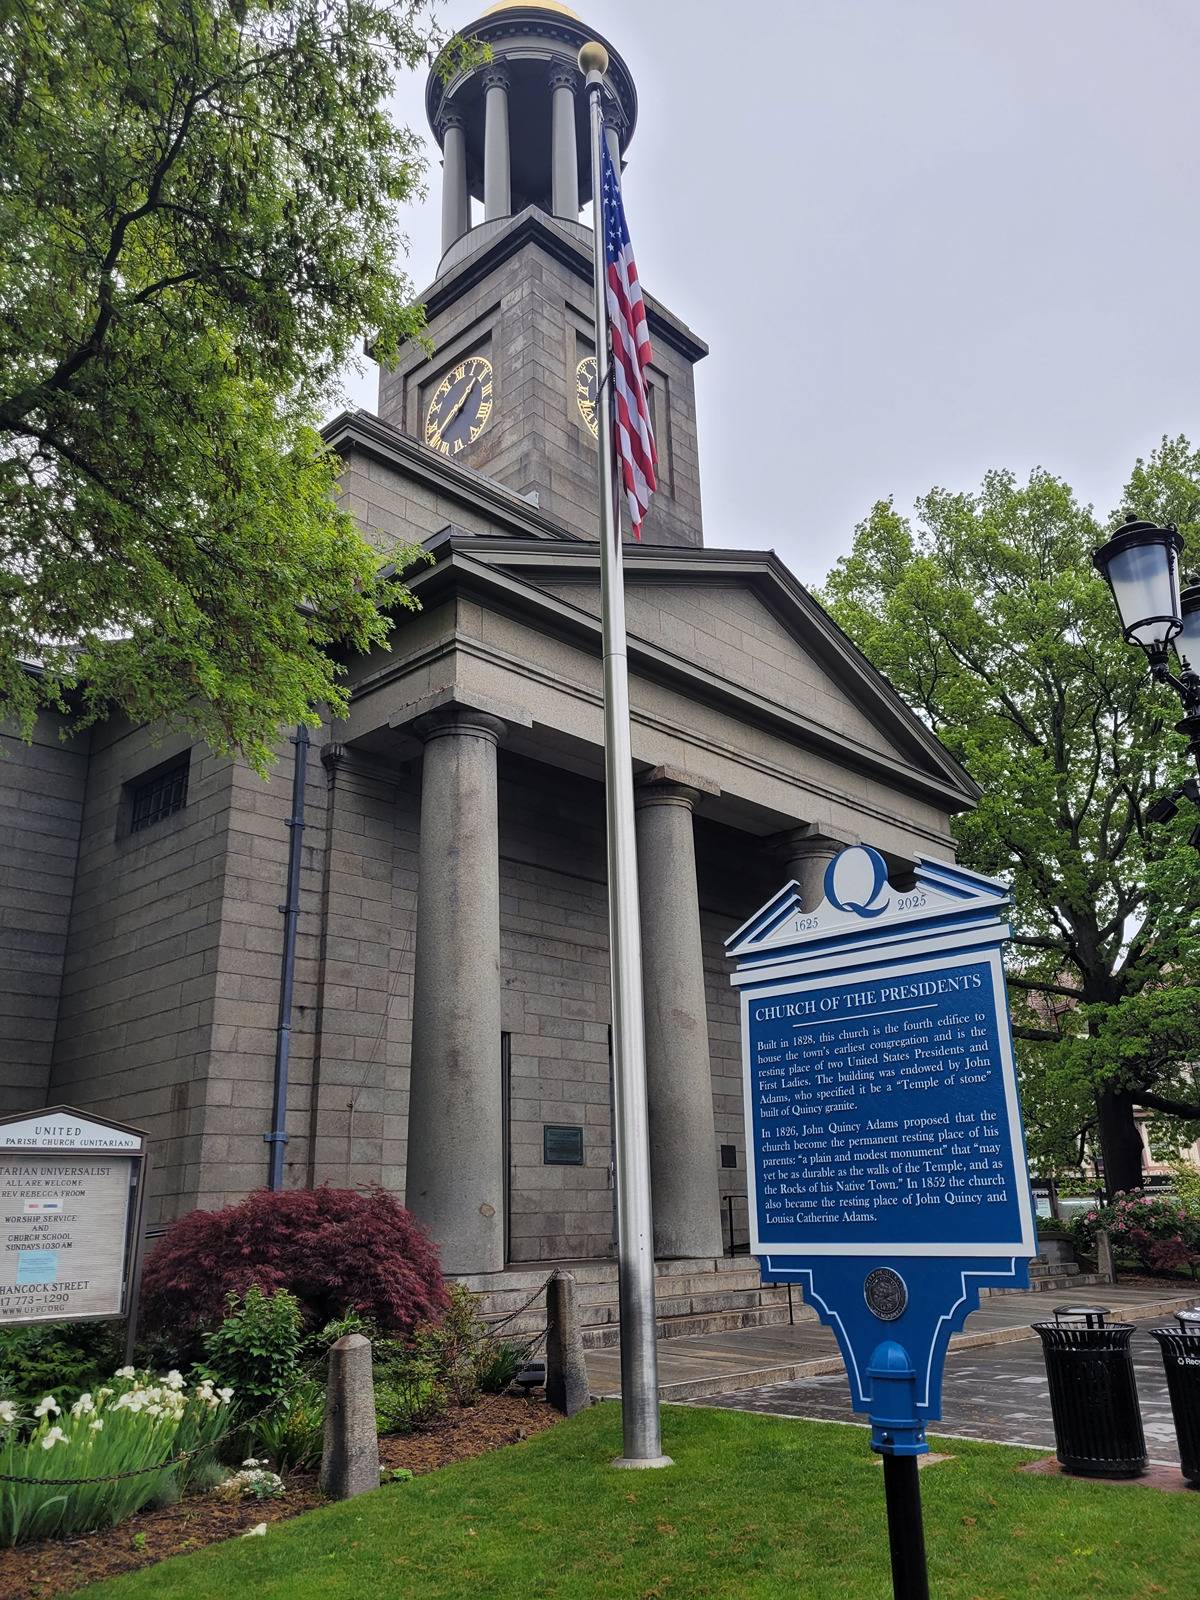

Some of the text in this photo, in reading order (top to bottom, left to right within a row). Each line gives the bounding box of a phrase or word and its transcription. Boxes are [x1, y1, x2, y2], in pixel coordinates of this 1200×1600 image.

[823, 844, 891, 918] Q
[794, 893, 927, 932] 1625 2025
[755, 973, 981, 1021] CHURCH OF THE PRESIDENTS
[757, 1013, 985, 1050] Built in 1828, this church is the fourth edifice to
[757, 1054, 781, 1064] house
[785, 1050, 798, 1060] the
[833, 1042, 865, 1054] earliest
[869, 1034, 929, 1049] congregation
[933, 1029, 952, 1041] and
[957, 1028, 965, 1038] is
[970, 1025, 986, 1037] the
[758, 1039, 988, 1077] resting place of two United States Presidents and
[759, 1056, 991, 1091] First Ladies. The building was endowed by John
[759, 1093, 790, 1104] Adams,
[794, 1090, 812, 1100] who
[816, 1084, 855, 1100] specified
[859, 1084, 866, 1094] it
[870, 1082, 881, 1093] be
[944, 1074, 955, 1085] of
[760, 1100, 857, 1118] built of Quincy granite.
[35, 1126, 82, 1136] UNITED
[761, 1109, 996, 1138] In 1826, John Quincy Adams proposed that the
[80, 1139, 134, 1147] (UNITARIAN)
[761, 1125, 999, 1152] church become the permanent resting place of his
[762, 1157, 796, 1168] parents:
[809, 1152, 832, 1165] plain
[834, 1150, 851, 1162] and
[853, 1148, 887, 1160] modest
[951, 1143, 971, 1155] that
[40, 1167, 112, 1176] UNIVERSALIST
[763, 1172, 775, 1182] yet
[777, 1169, 788, 1179] be
[802, 1166, 835, 1178] durable
[849, 1165, 864, 1176] the
[866, 1163, 889, 1174] walls
[892, 1162, 903, 1173] of
[904, 1162, 920, 1173] the
[922, 1159, 966, 1173] Temple,
[969, 1157, 989, 1170] and
[992, 1160, 1003, 1169] as
[764, 1184, 777, 1194] the
[780, 1183, 806, 1194] Rocks
[808, 1182, 818, 1192] of
[820, 1181, 833, 1192] his
[836, 1180, 865, 1191] Native
[906, 1177, 918, 1189] In
[921, 1176, 945, 1188] 1852
[948, 1175, 965, 1187] the
[968, 1173, 1005, 1186] church
[765, 1189, 1007, 1209] also became the resting place of John Quincy and
[766, 1210, 877, 1223] Louisa Catherine Adams.
[5, 1243, 41, 1251] SUNDAYS
[0, 1281, 90, 1295] HANCOCK STREET
[15, 1293, 69, 1305] 773-1290
